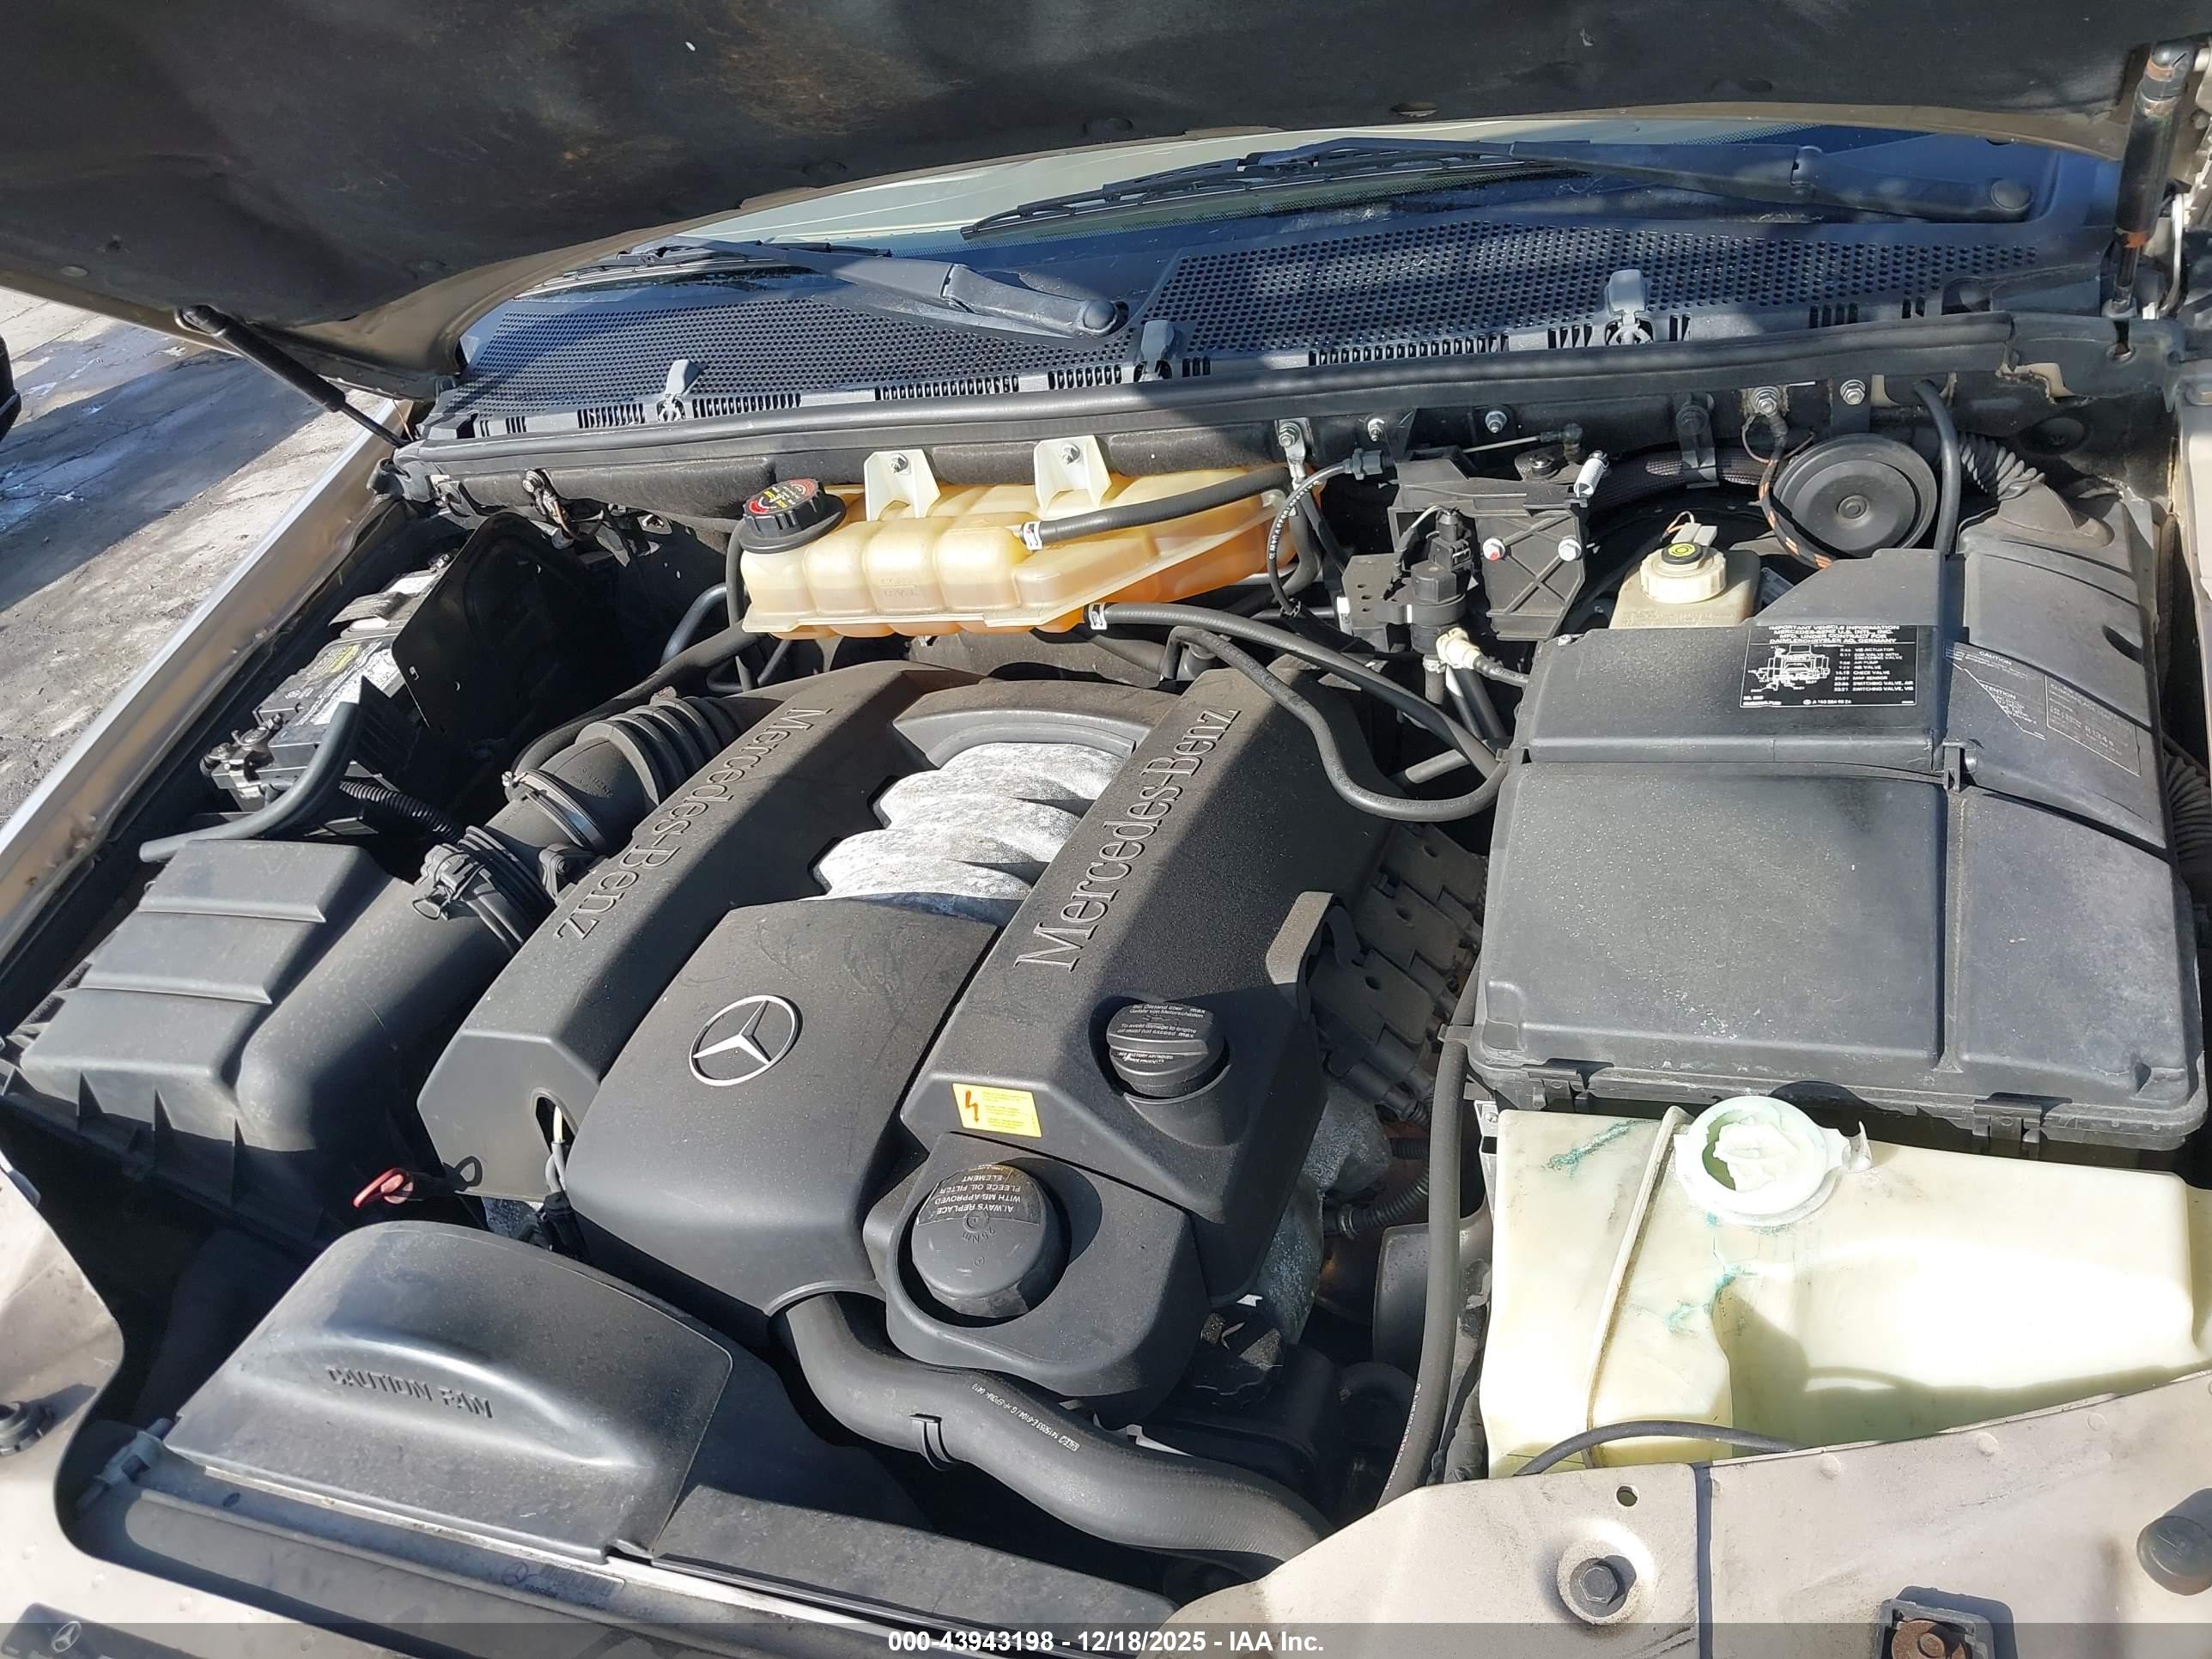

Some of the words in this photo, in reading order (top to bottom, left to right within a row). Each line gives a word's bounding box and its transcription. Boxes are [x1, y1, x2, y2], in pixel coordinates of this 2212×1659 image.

[1978, 651, 2012, 665] CAUTION
[553, 707, 834, 941] Mercedes-Benz
[1012, 709, 1243, 973] Mercedes-Benz
[939, 1183, 968, 1194] FILTER
[936, 1204, 975, 1215] REPLACE
[977, 1204, 1014, 1213] ALWAYS
[325, 1364, 433, 1401] CAUTION
[438, 1386, 493, 1419] FAN
